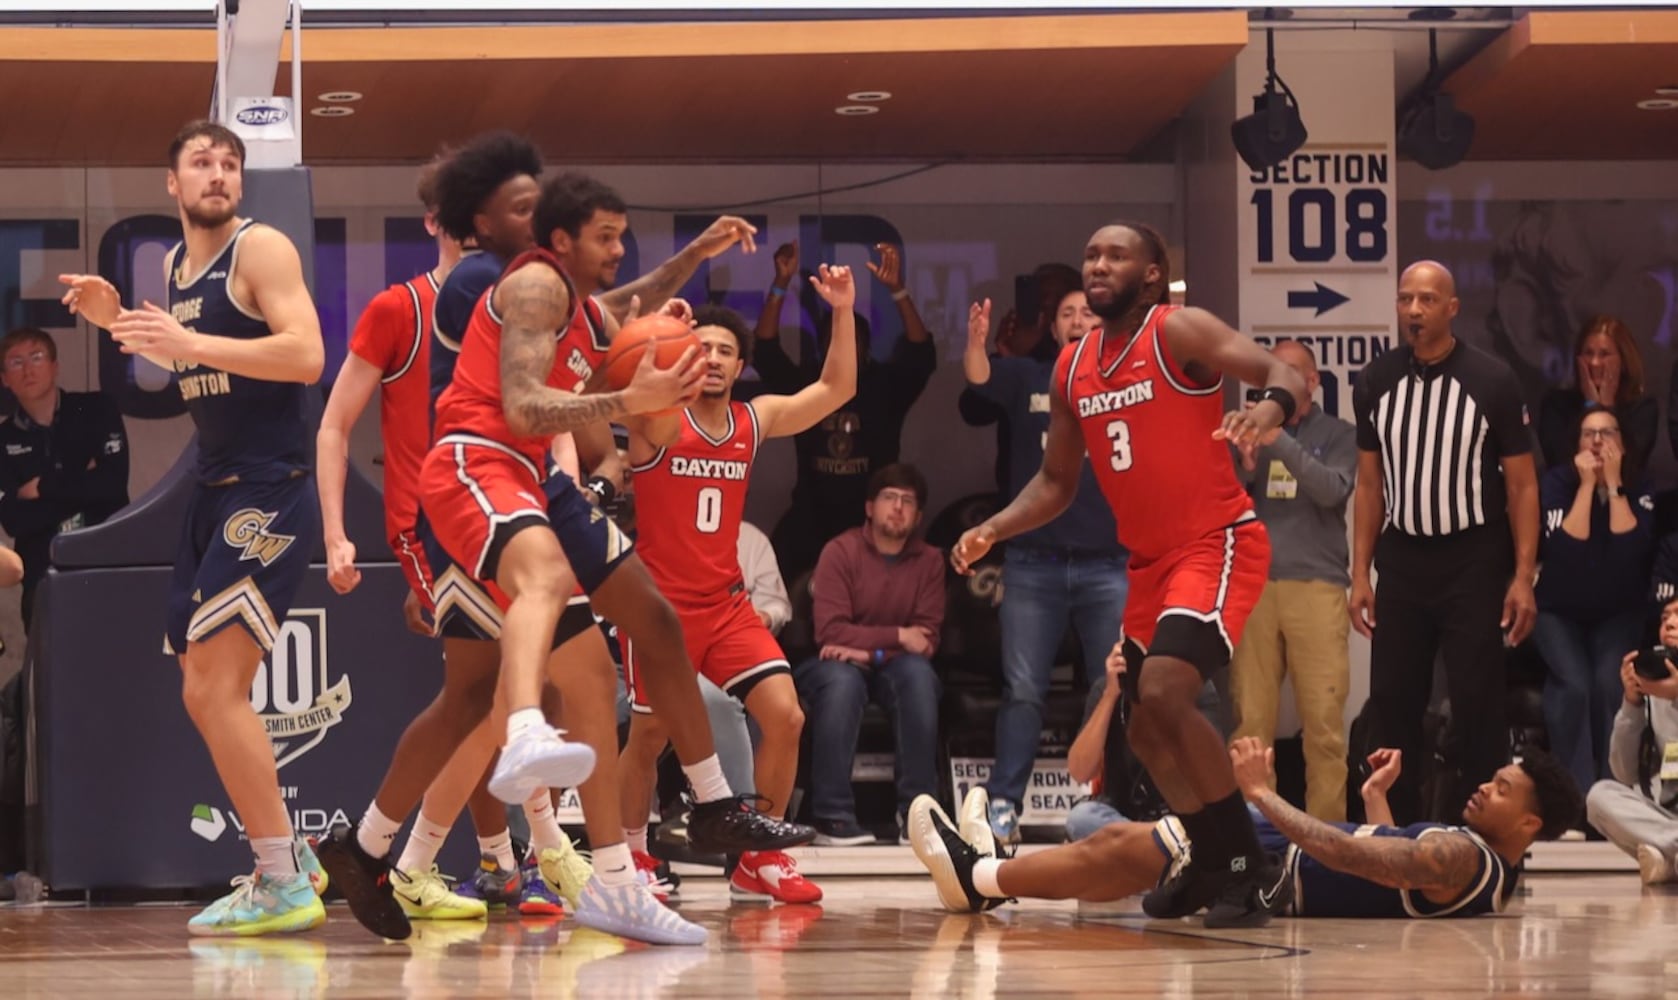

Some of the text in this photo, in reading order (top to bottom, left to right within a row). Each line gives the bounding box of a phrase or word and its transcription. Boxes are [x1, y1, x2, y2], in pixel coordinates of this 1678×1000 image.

[1251, 188, 1388, 263] 108
[1253, 335, 1390, 366] TION
[1078, 379, 1154, 418] DAYTON
[1106, 420, 1133, 472] 3
[671, 456, 748, 480] DAYTON
[696, 486, 722, 533] 0
[265, 706, 334, 733] SMITH CENTER
[1033, 771, 1071, 787] ROW
[1031, 794, 1074, 810] SEAT
